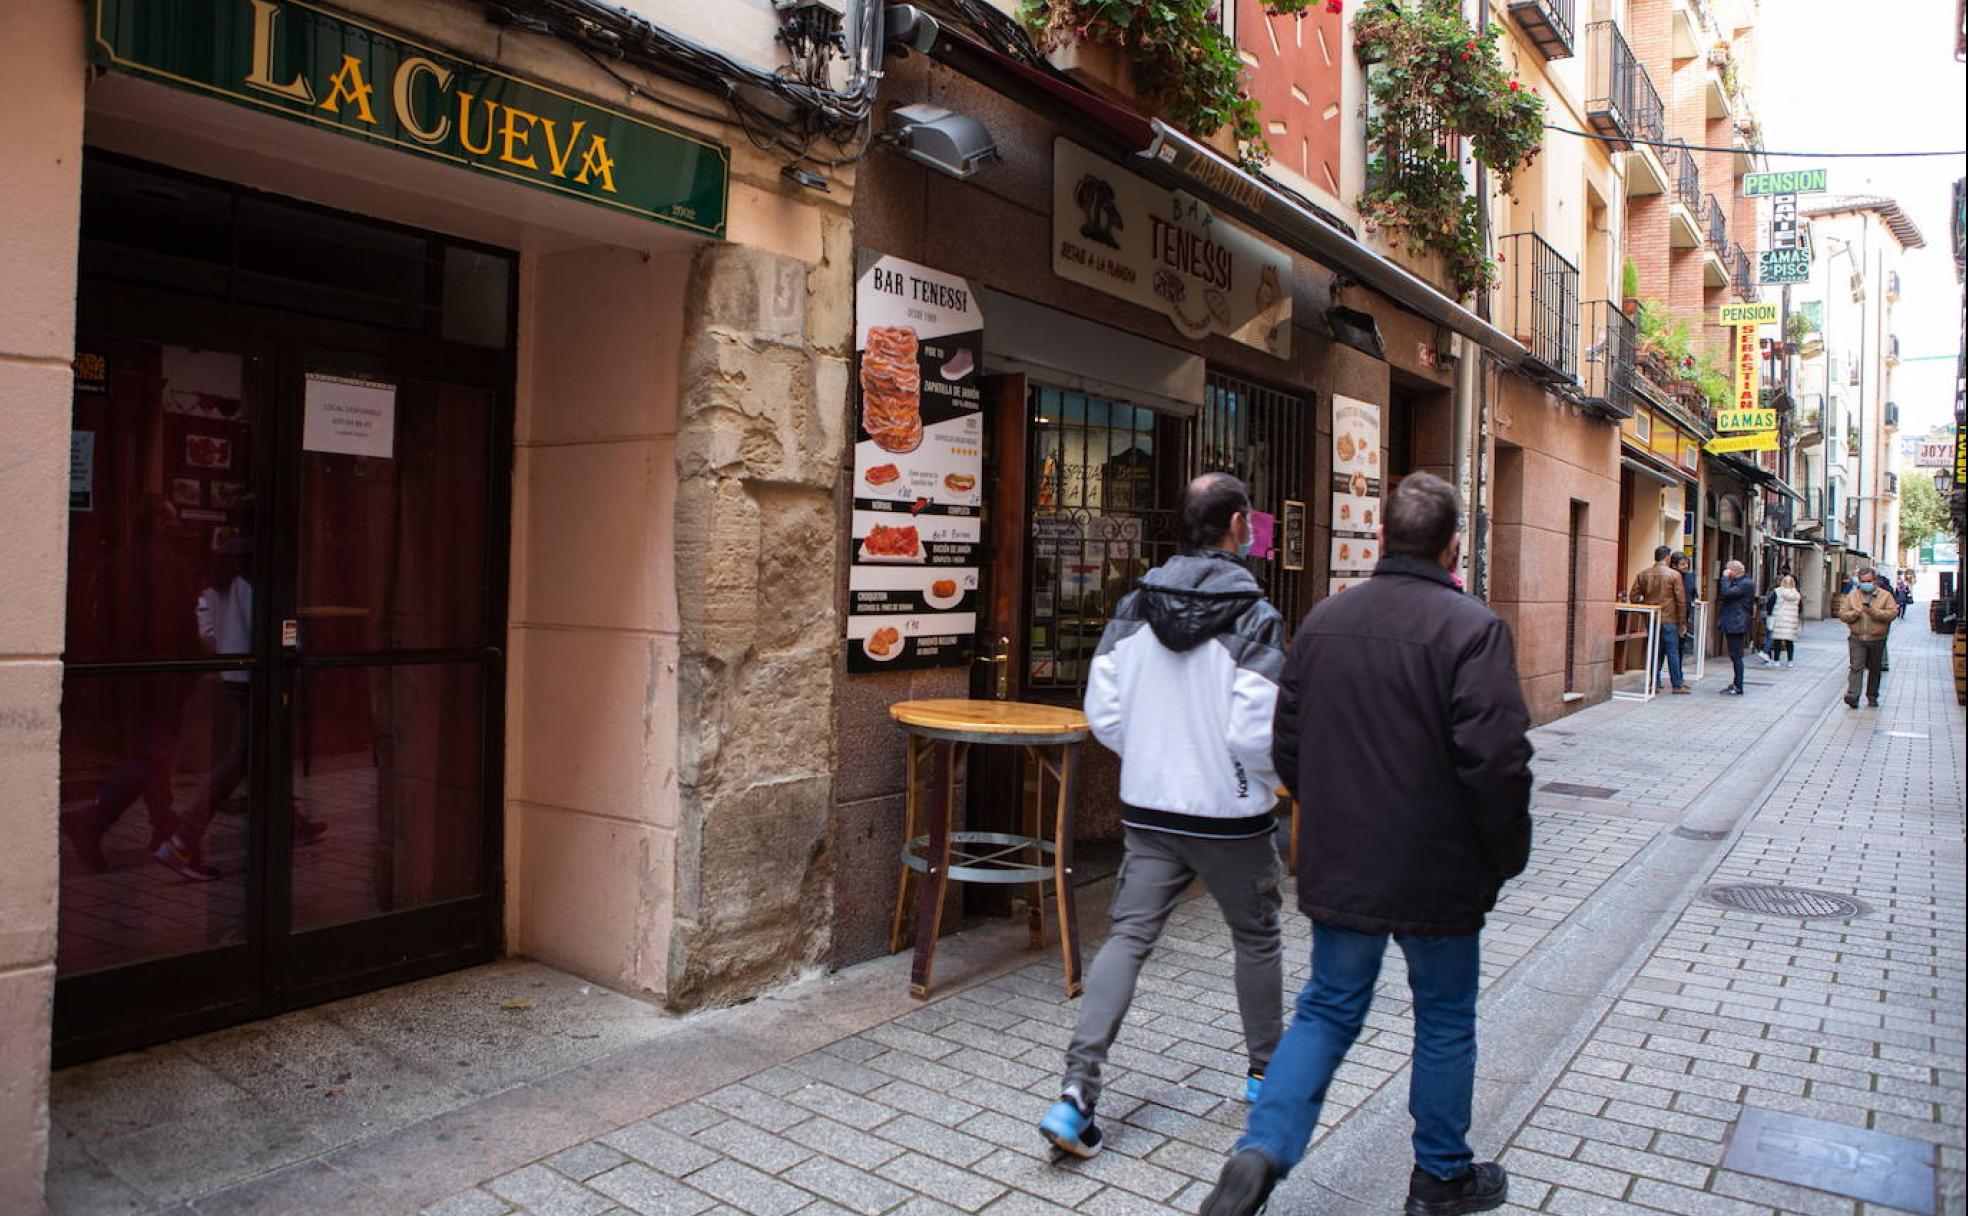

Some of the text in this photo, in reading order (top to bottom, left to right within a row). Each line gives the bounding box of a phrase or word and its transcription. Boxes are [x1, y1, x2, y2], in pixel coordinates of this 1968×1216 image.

[244, 0, 618, 194] LA CUEVA
[1746, 170, 1825, 194] PENSION
[1149, 214, 1233, 292] TENESSI
[1760, 249, 1808, 264] CAMAS
[1773, 263, 1808, 277] PISO
[874, 267, 968, 313] BAR TENESSI
[1722, 306, 1775, 321] PENSION
[1740, 325, 1754, 409] SEBASTIAN
[1720, 413, 1774, 428] CAMAS
